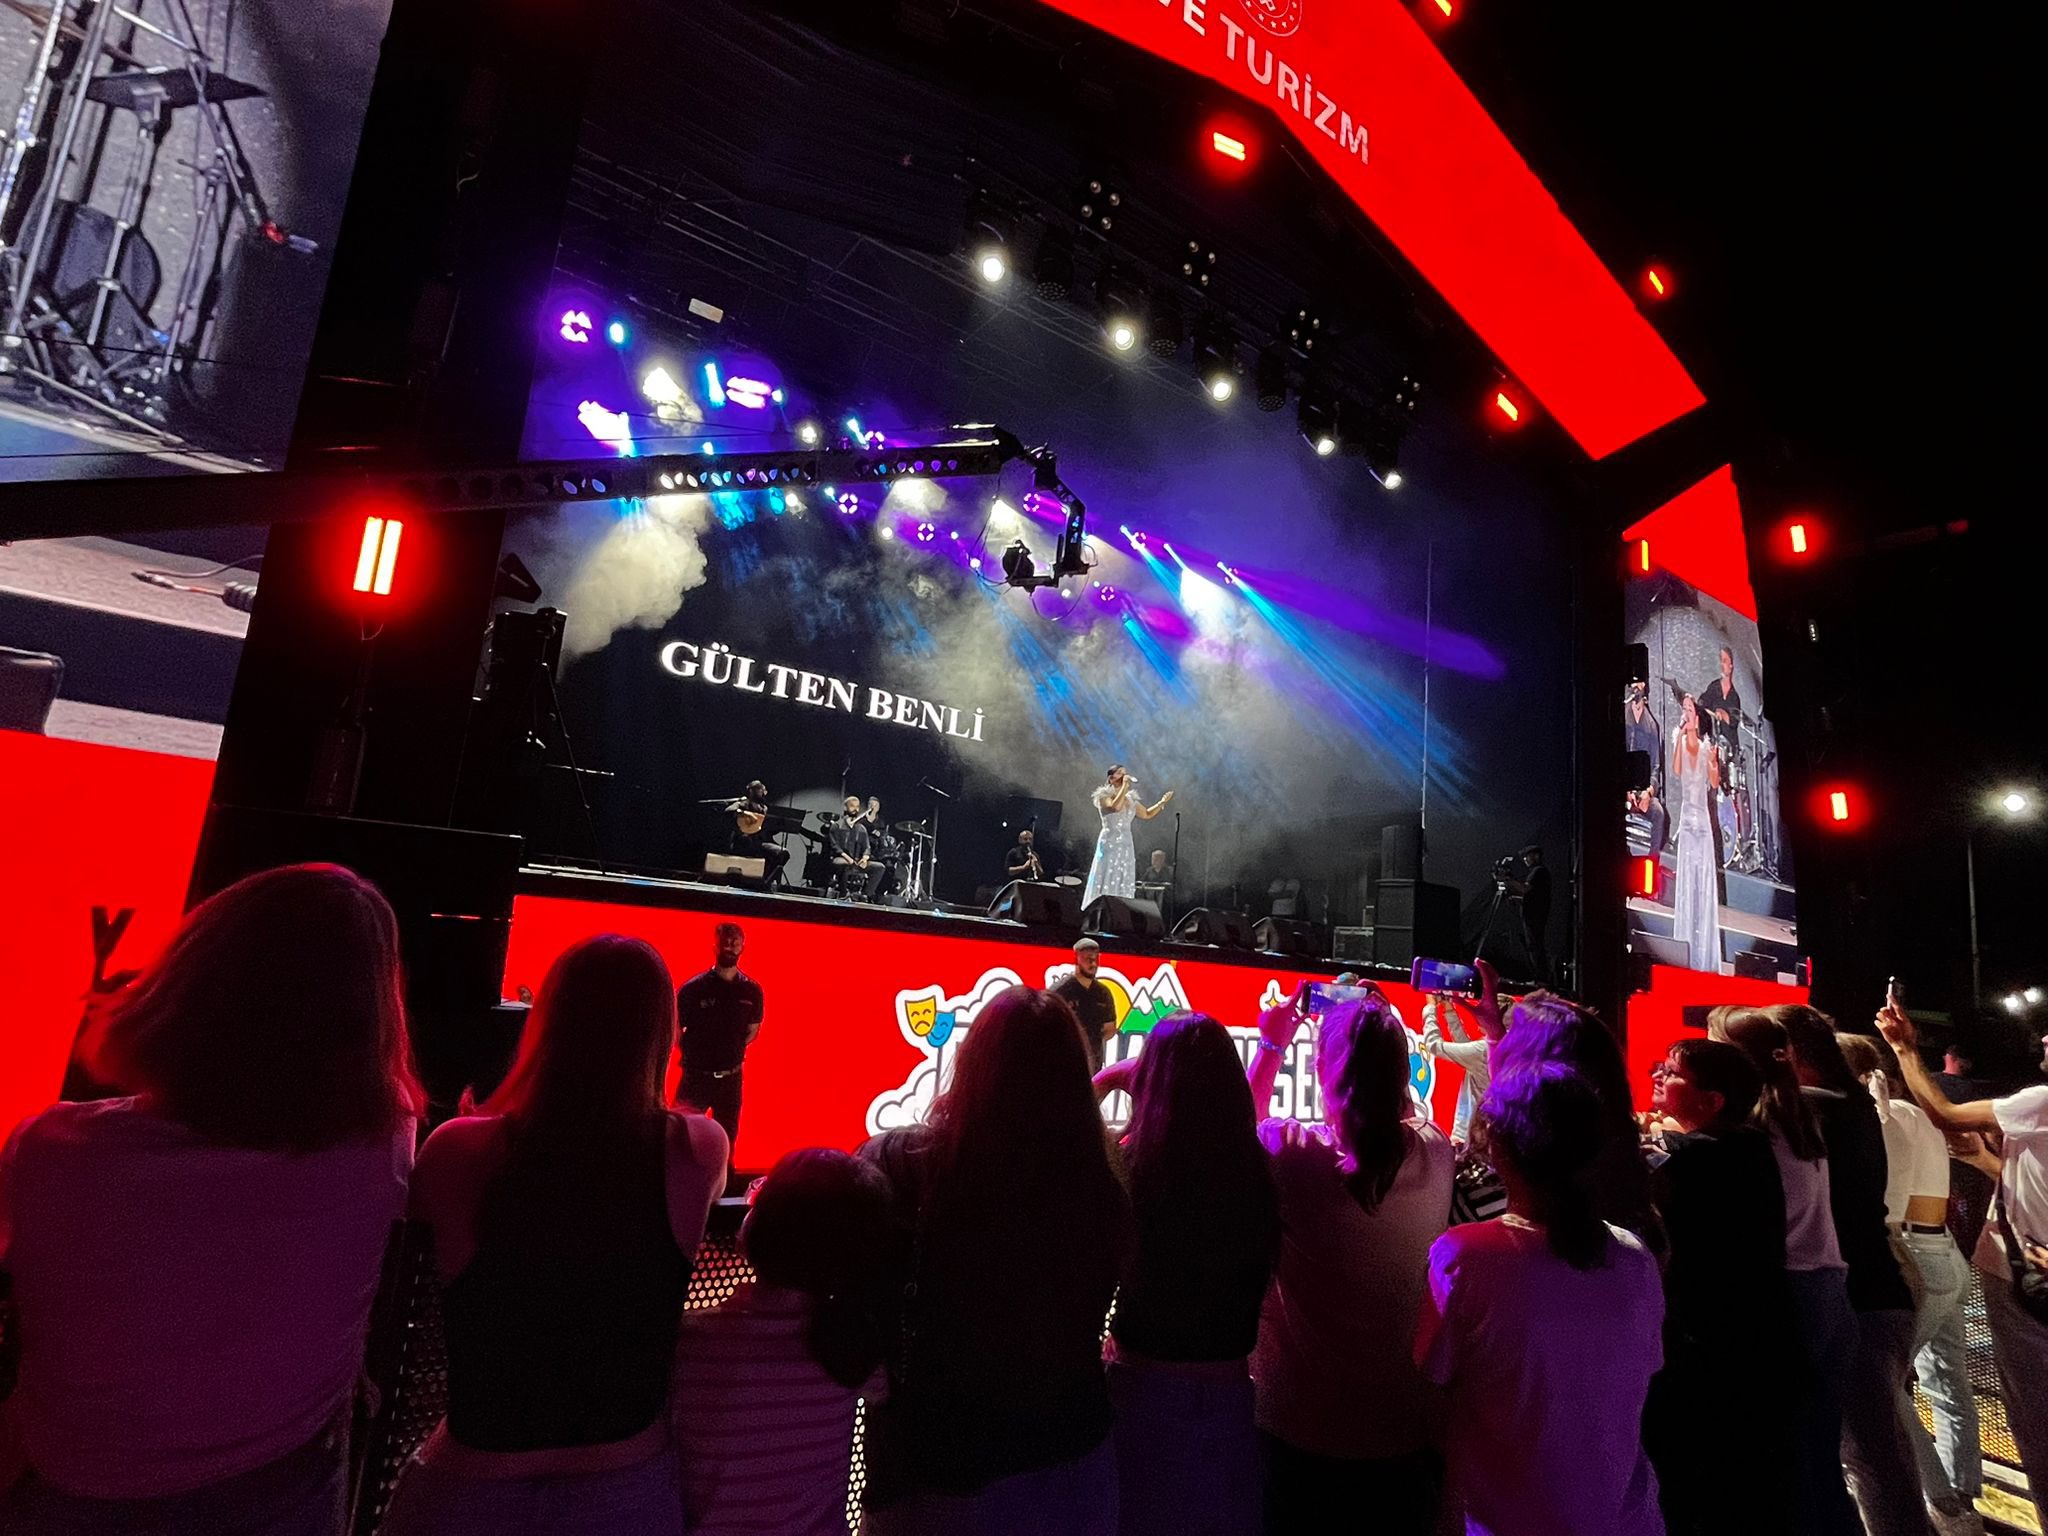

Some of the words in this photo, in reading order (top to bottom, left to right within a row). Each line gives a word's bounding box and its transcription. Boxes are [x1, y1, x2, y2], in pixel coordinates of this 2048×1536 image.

[1158, 0, 1206, 37] E
[1219, 12, 1369, 165] TURİZM
[659, 640, 859, 714] GÜLTEN
[864, 685, 987, 743] BENLİ
